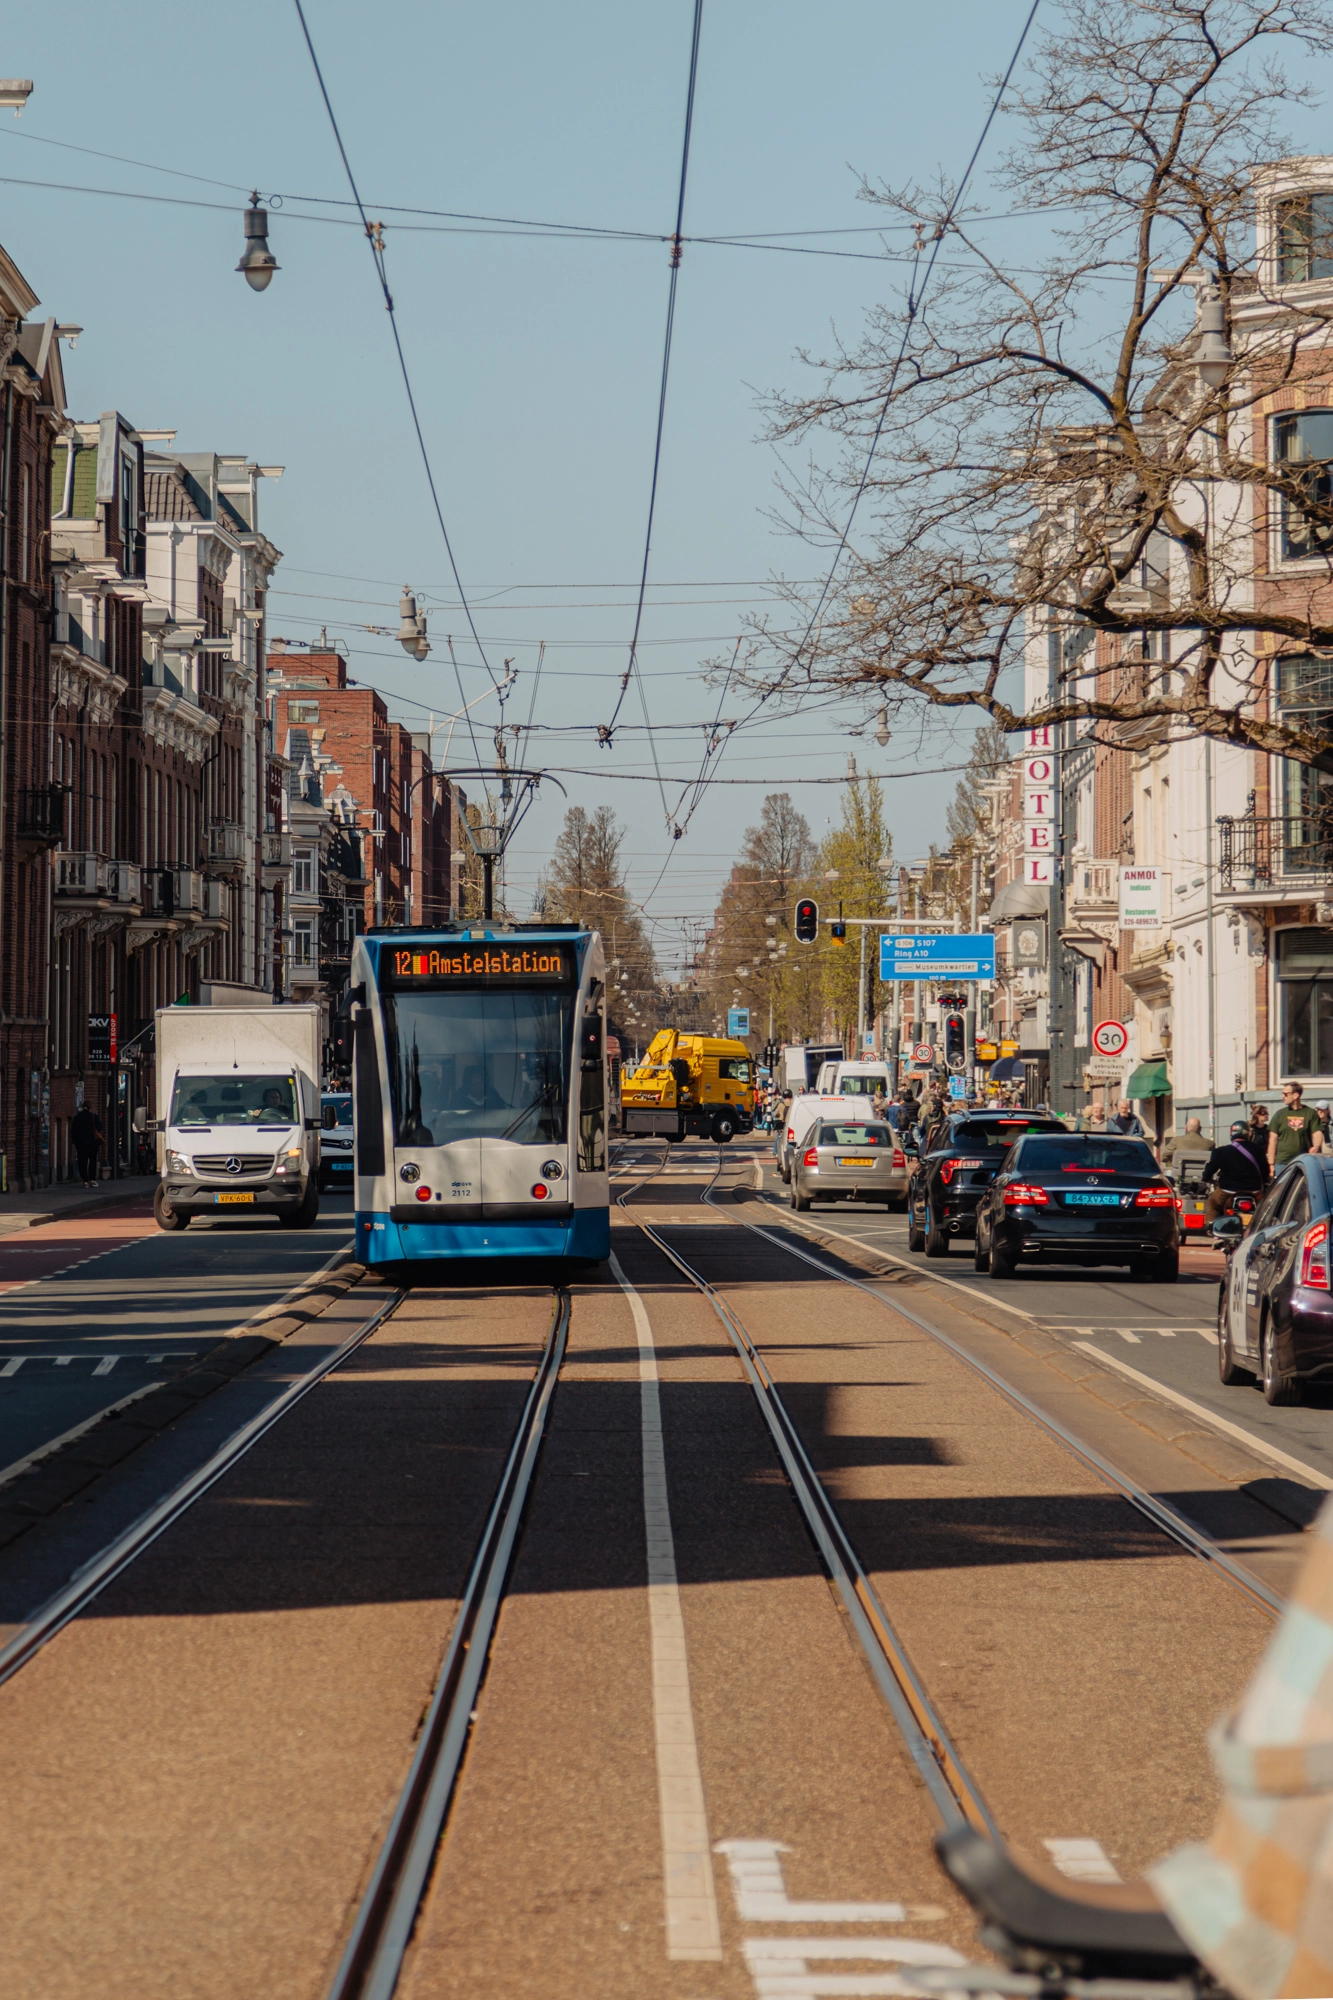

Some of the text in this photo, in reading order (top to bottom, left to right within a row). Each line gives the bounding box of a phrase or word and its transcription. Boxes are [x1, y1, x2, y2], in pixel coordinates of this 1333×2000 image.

[1029, 726, 1051, 881] HOTEL
[1124, 871, 1157, 880] ANMOL
[894, 950, 913, 959] Ring
[395, 950, 561, 975] 12 Amstelstation
[1100, 1033, 1121, 1046] 30
[918, 1049, 930, 1057] 30
